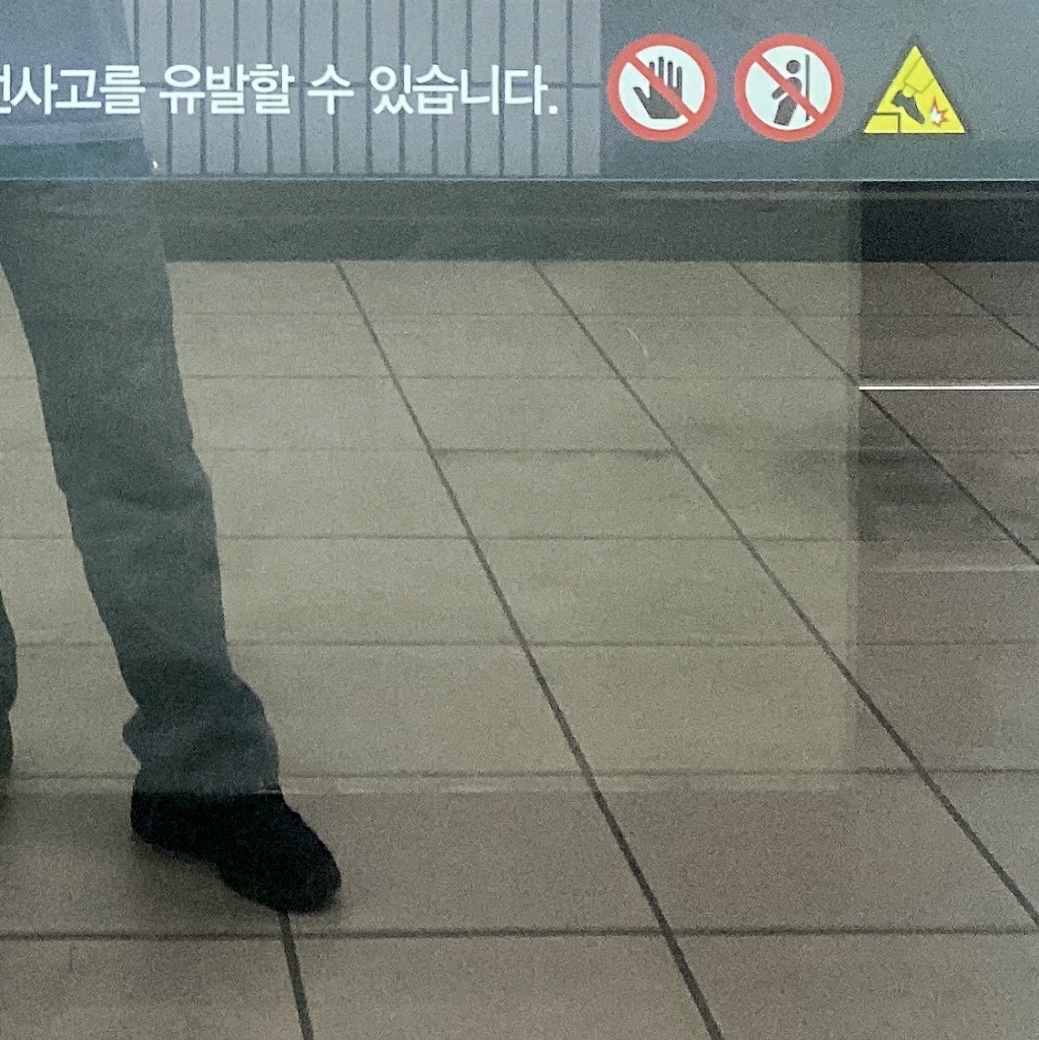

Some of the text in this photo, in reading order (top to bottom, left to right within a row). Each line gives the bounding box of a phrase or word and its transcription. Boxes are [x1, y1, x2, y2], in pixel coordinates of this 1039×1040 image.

[159, 63, 295, 115] 유발할
[306, 64, 355, 115] 수
[369, 63, 559, 115] 있습니다.
